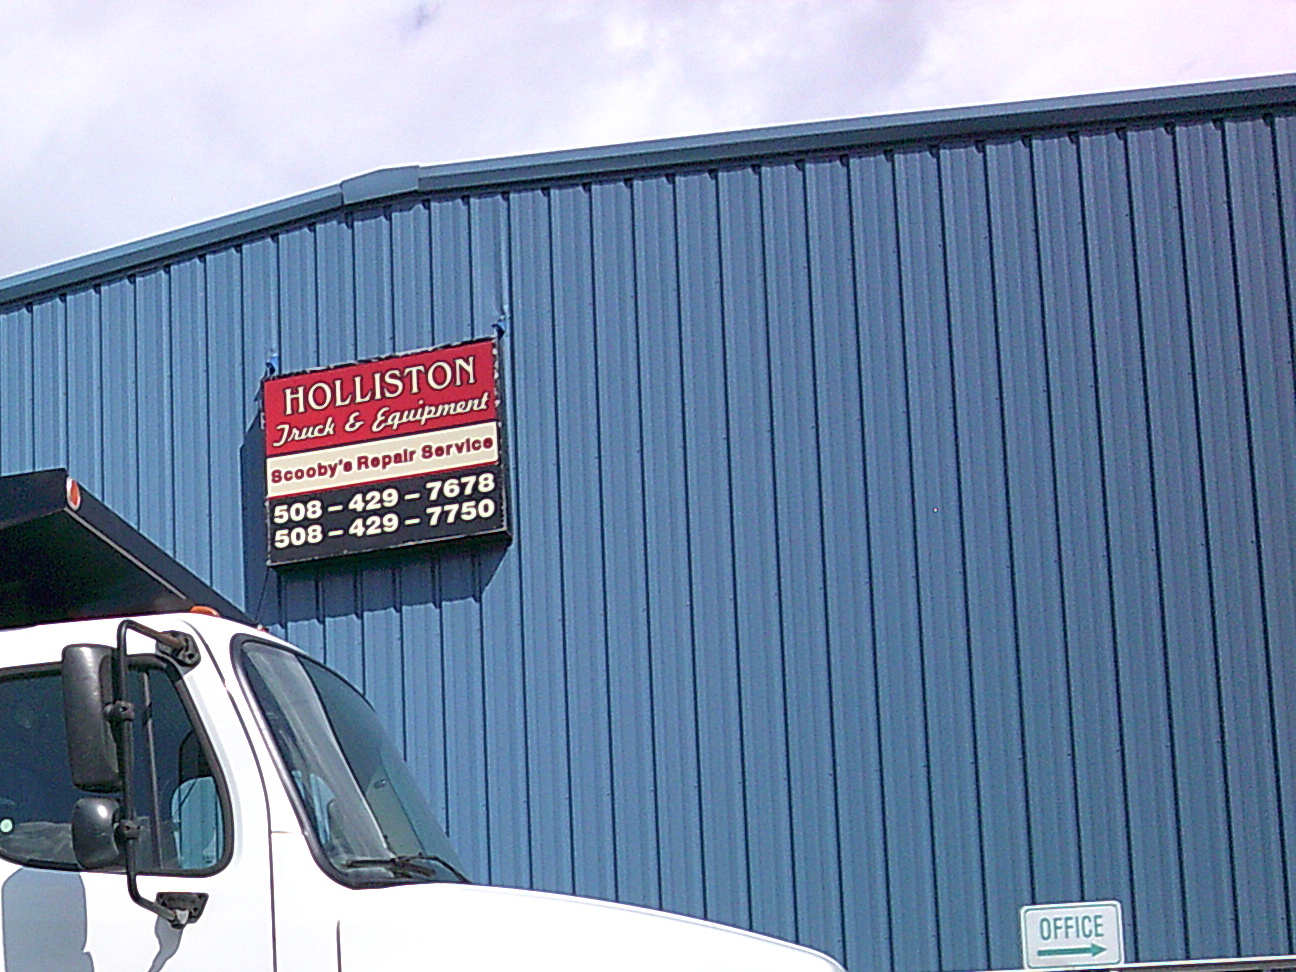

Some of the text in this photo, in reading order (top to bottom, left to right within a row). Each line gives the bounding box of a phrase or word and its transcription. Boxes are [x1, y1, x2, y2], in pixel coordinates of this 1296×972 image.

[284, 356, 476, 415] HOLLISTON
[272, 417, 335, 447] Truck
[344, 411, 365, 432] &
[371, 391, 490, 432] Equipment
[270, 436, 494, 484] Scooby's Repair Service
[1039, 914, 1105, 941] OFFICE
